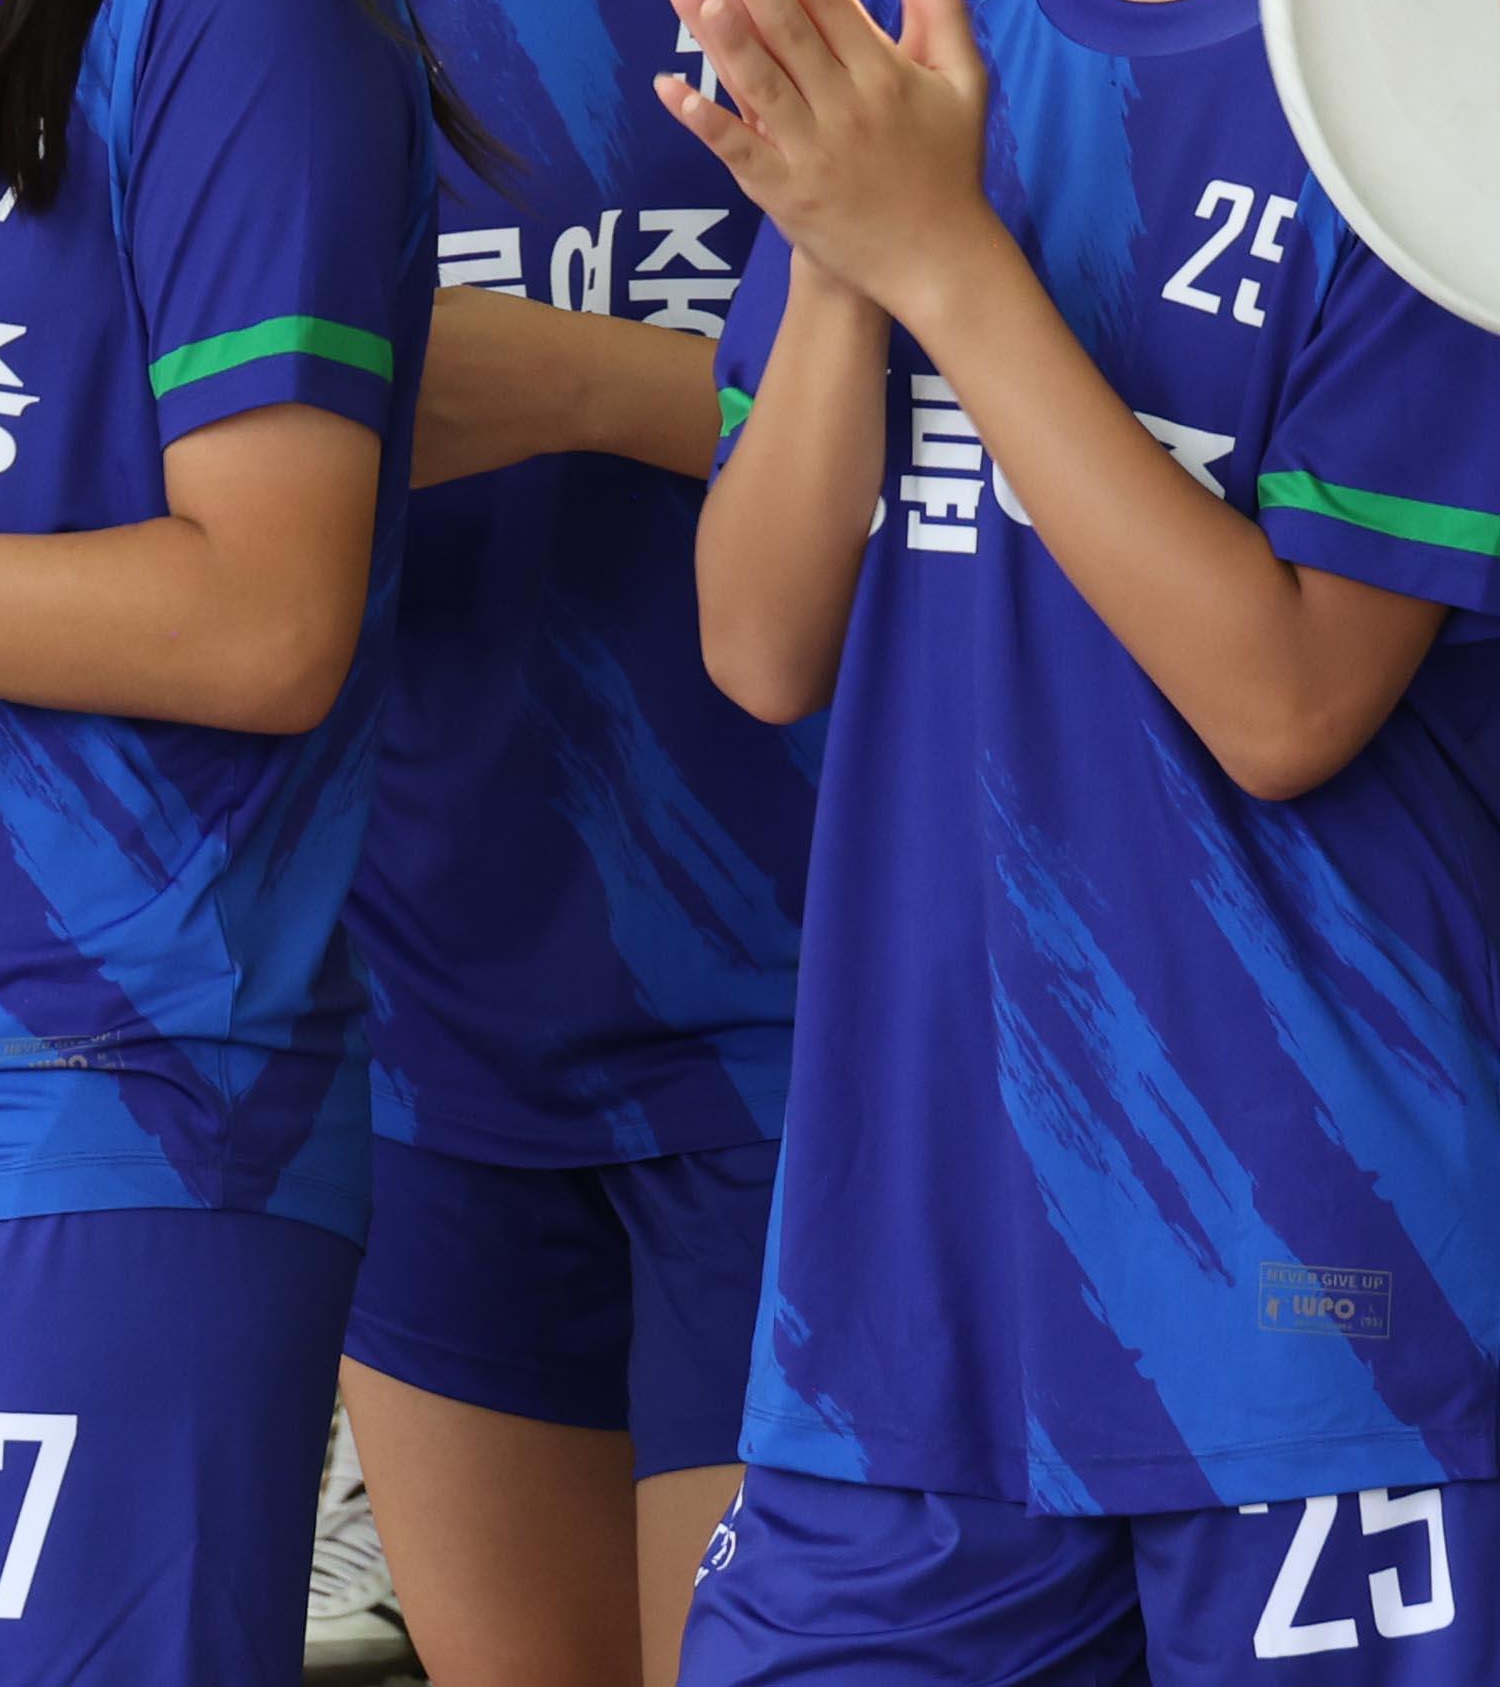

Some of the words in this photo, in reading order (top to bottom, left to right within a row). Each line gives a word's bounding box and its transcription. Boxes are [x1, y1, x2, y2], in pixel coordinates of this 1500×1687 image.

[1321, 1272, 1357, 1289] GIVE
[1361, 1276, 1385, 1290] UP
[1239, 1487, 1456, 1659] 25
